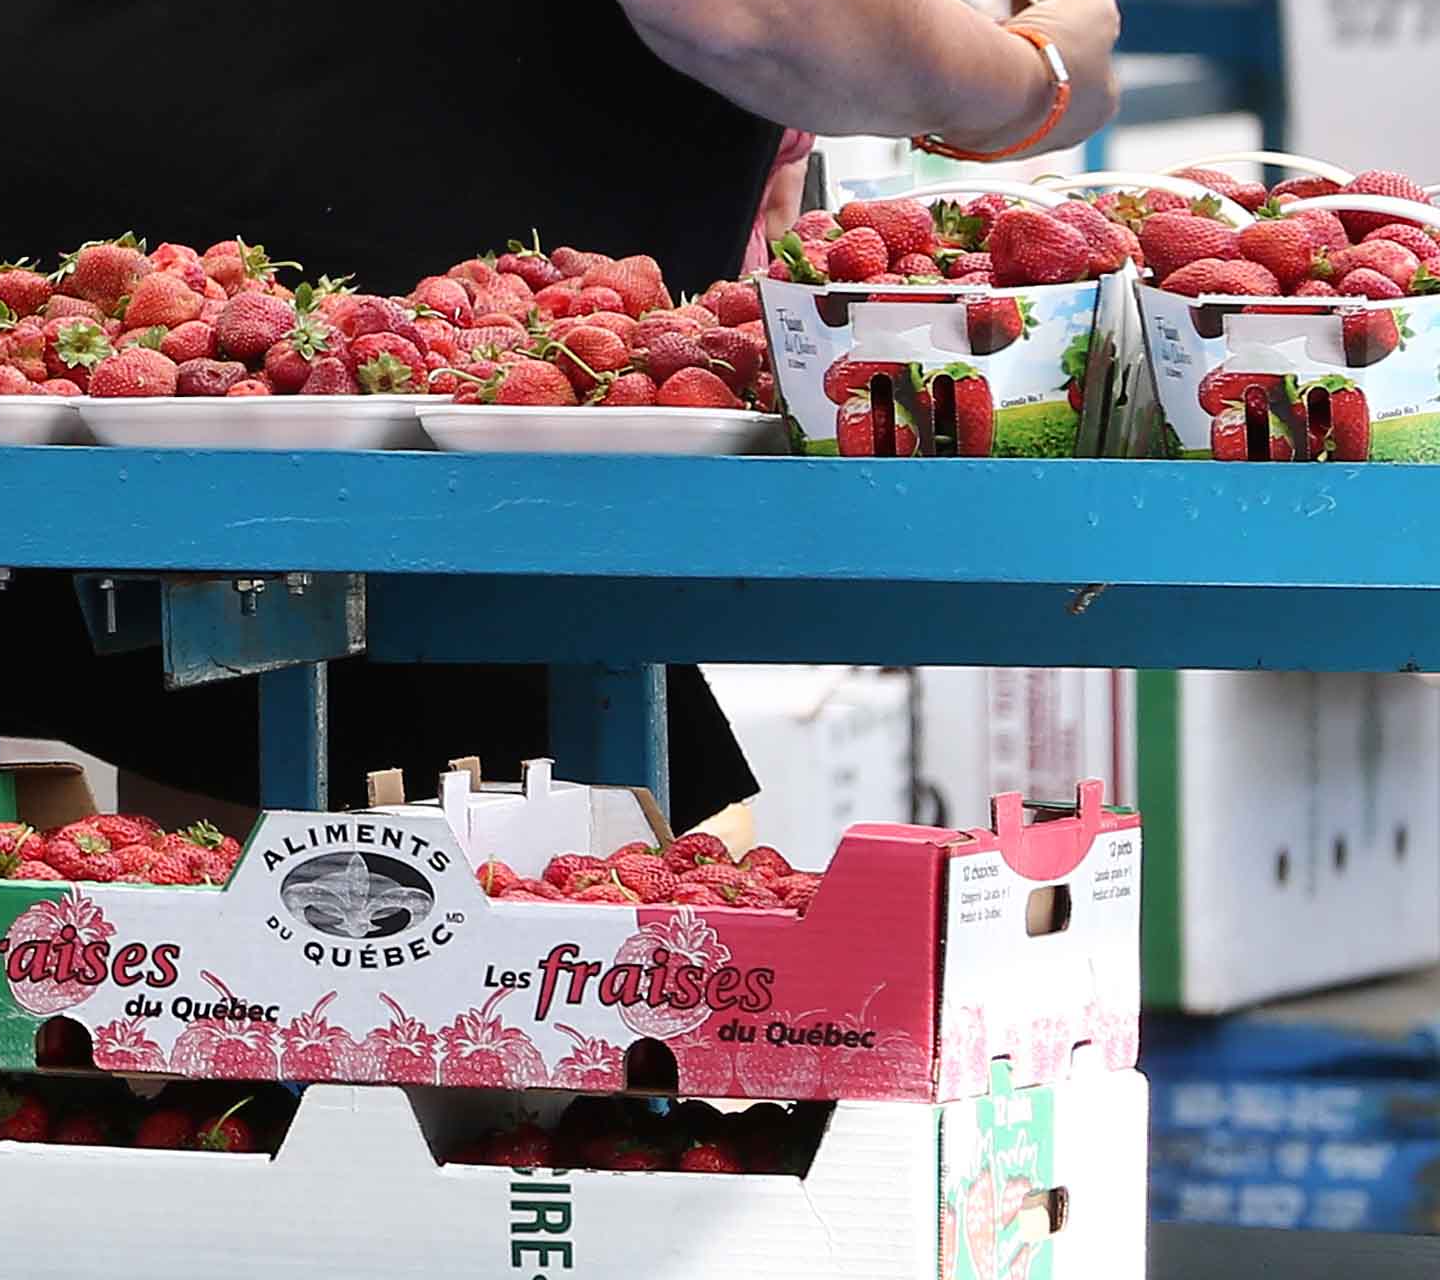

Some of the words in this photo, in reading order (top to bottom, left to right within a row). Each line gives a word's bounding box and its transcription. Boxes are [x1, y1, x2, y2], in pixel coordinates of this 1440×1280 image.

[999, 394, 1026, 409] Canada
[1375, 408, 1402, 421] Canada
[262, 824, 451, 873] ALIMENTS
[265, 915, 294, 940] DU
[303, 922, 454, 969] QUÉBEC
[446, 912, 465, 925] MD
[484, 964, 531, 989] Les
[534, 943, 775, 1021] fraises
[125, 994, 162, 1019] du
[171, 994, 280, 1023] Québec
[717, 1018, 756, 1044] du
[765, 1020, 877, 1049] Québec
[509, 1168, 573, 1269] IRE
